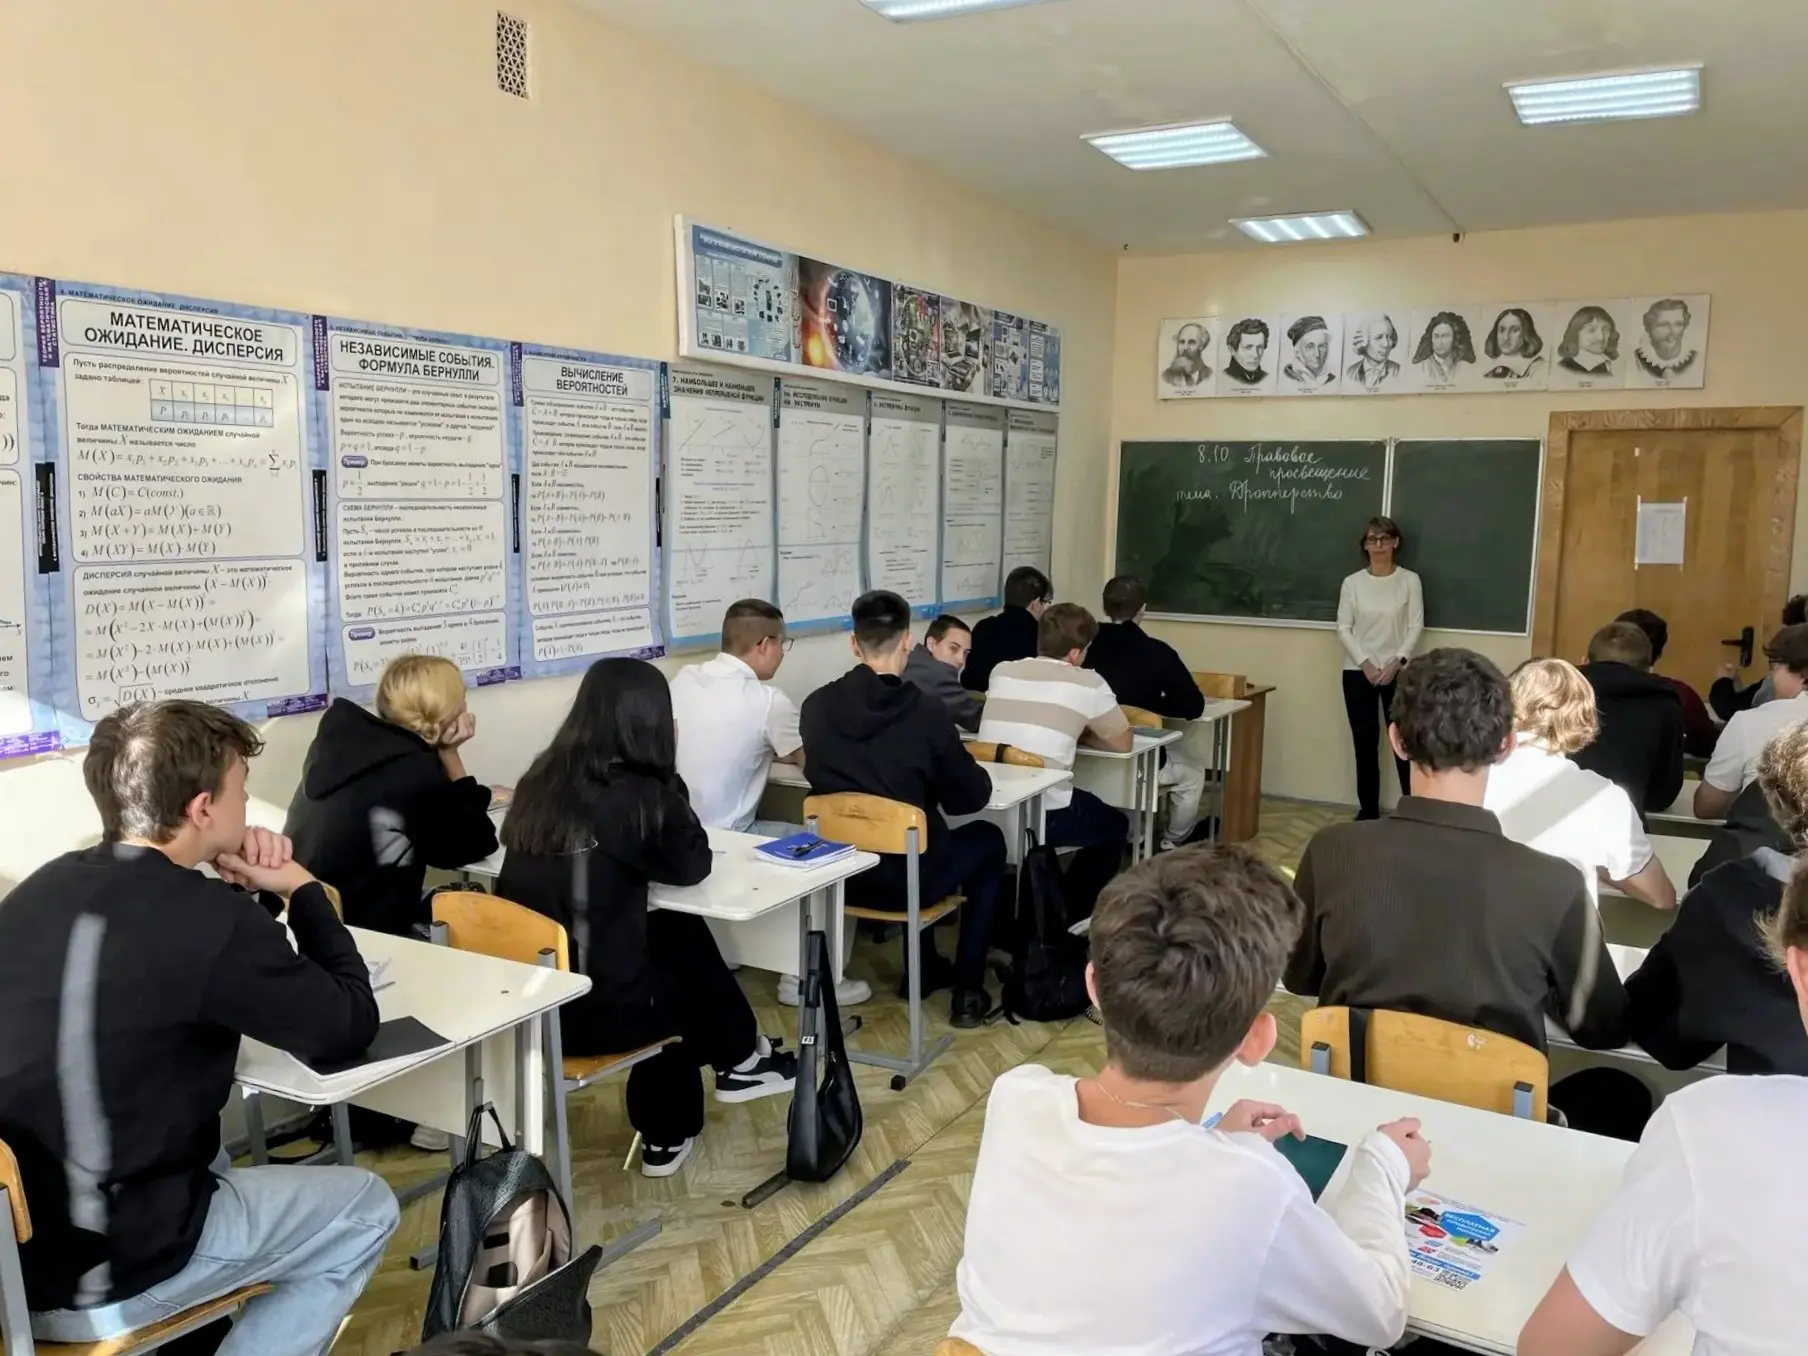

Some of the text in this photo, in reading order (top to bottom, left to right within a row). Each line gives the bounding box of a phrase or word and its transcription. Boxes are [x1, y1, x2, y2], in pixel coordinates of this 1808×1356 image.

[110, 311, 263, 343] МАТЕМАТИЧЕСКОЕ
[84, 327, 283, 361] ОЖИДАНИЕ. ДИСПЕРСИЯ
[340, 339, 495, 369] НЕЗАВИСИМЫЕ СОБЫТИЯ.
[73, 358, 97, 369] Пусть
[358, 358, 480, 381] ФОРМУЛА БЕРНУЛЛИ
[561, 366, 624, 384] ВЫЧИСЛЕНИЕ
[680, 377, 718, 388] НАИБОЛЬШЕЕ
[556, 379, 629, 396] ВЕРОЯТНОСТЕЙ
[76, 422, 99, 432] Тогда
[100, 424, 176, 435] МАТЕМАТИЧЕСКИМ
[177, 427, 224, 438] ОЖИДАНИЕМ
[1198, 442, 1323, 475] 8.10 Правовое
[77, 472, 122, 482] СВОЙСТВА
[124, 474, 200, 484] МАТЕМАТИЧЕСКОГО
[1268, 465, 1371, 487] просвещение
